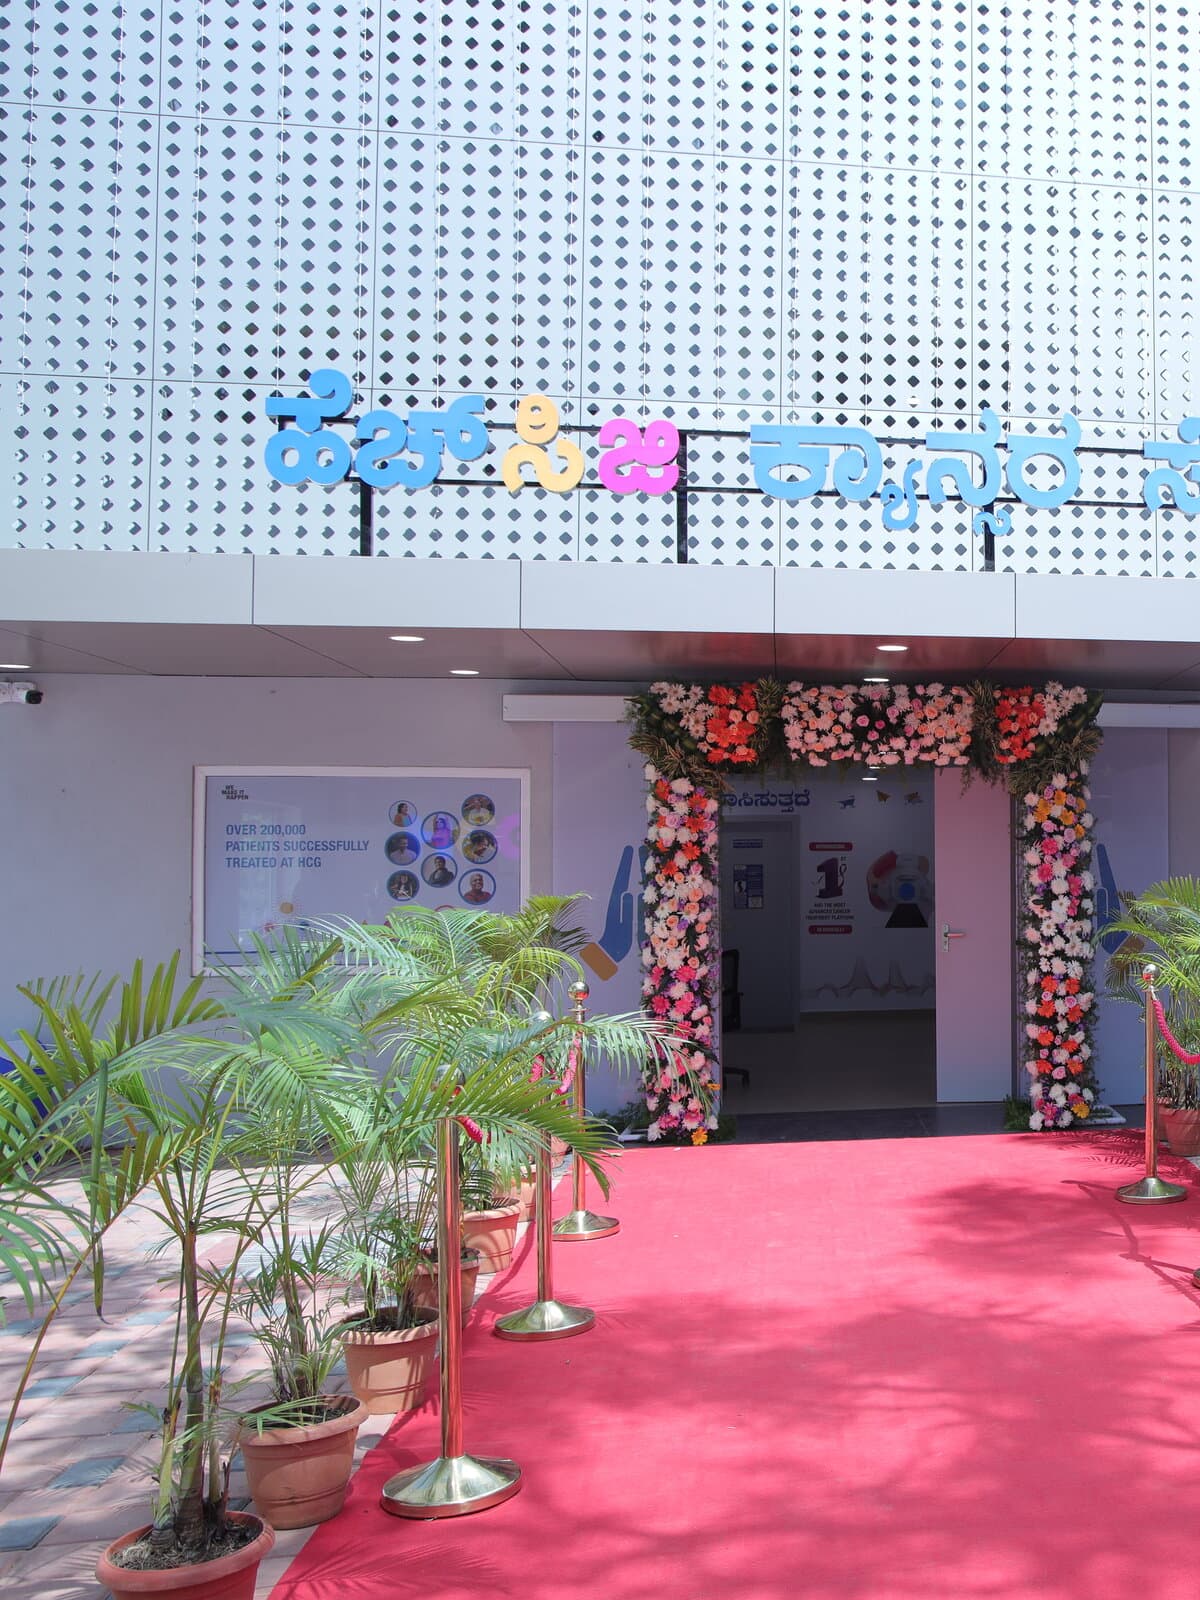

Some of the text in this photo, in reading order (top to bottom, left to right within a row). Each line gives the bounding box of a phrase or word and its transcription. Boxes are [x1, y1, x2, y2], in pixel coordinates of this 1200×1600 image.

[225, 824, 306, 837] OVER 200,000
[225, 839, 370, 852] PATIENTS SUCCESSFULLY
[225, 857, 321, 868] TREATED AT HCG
